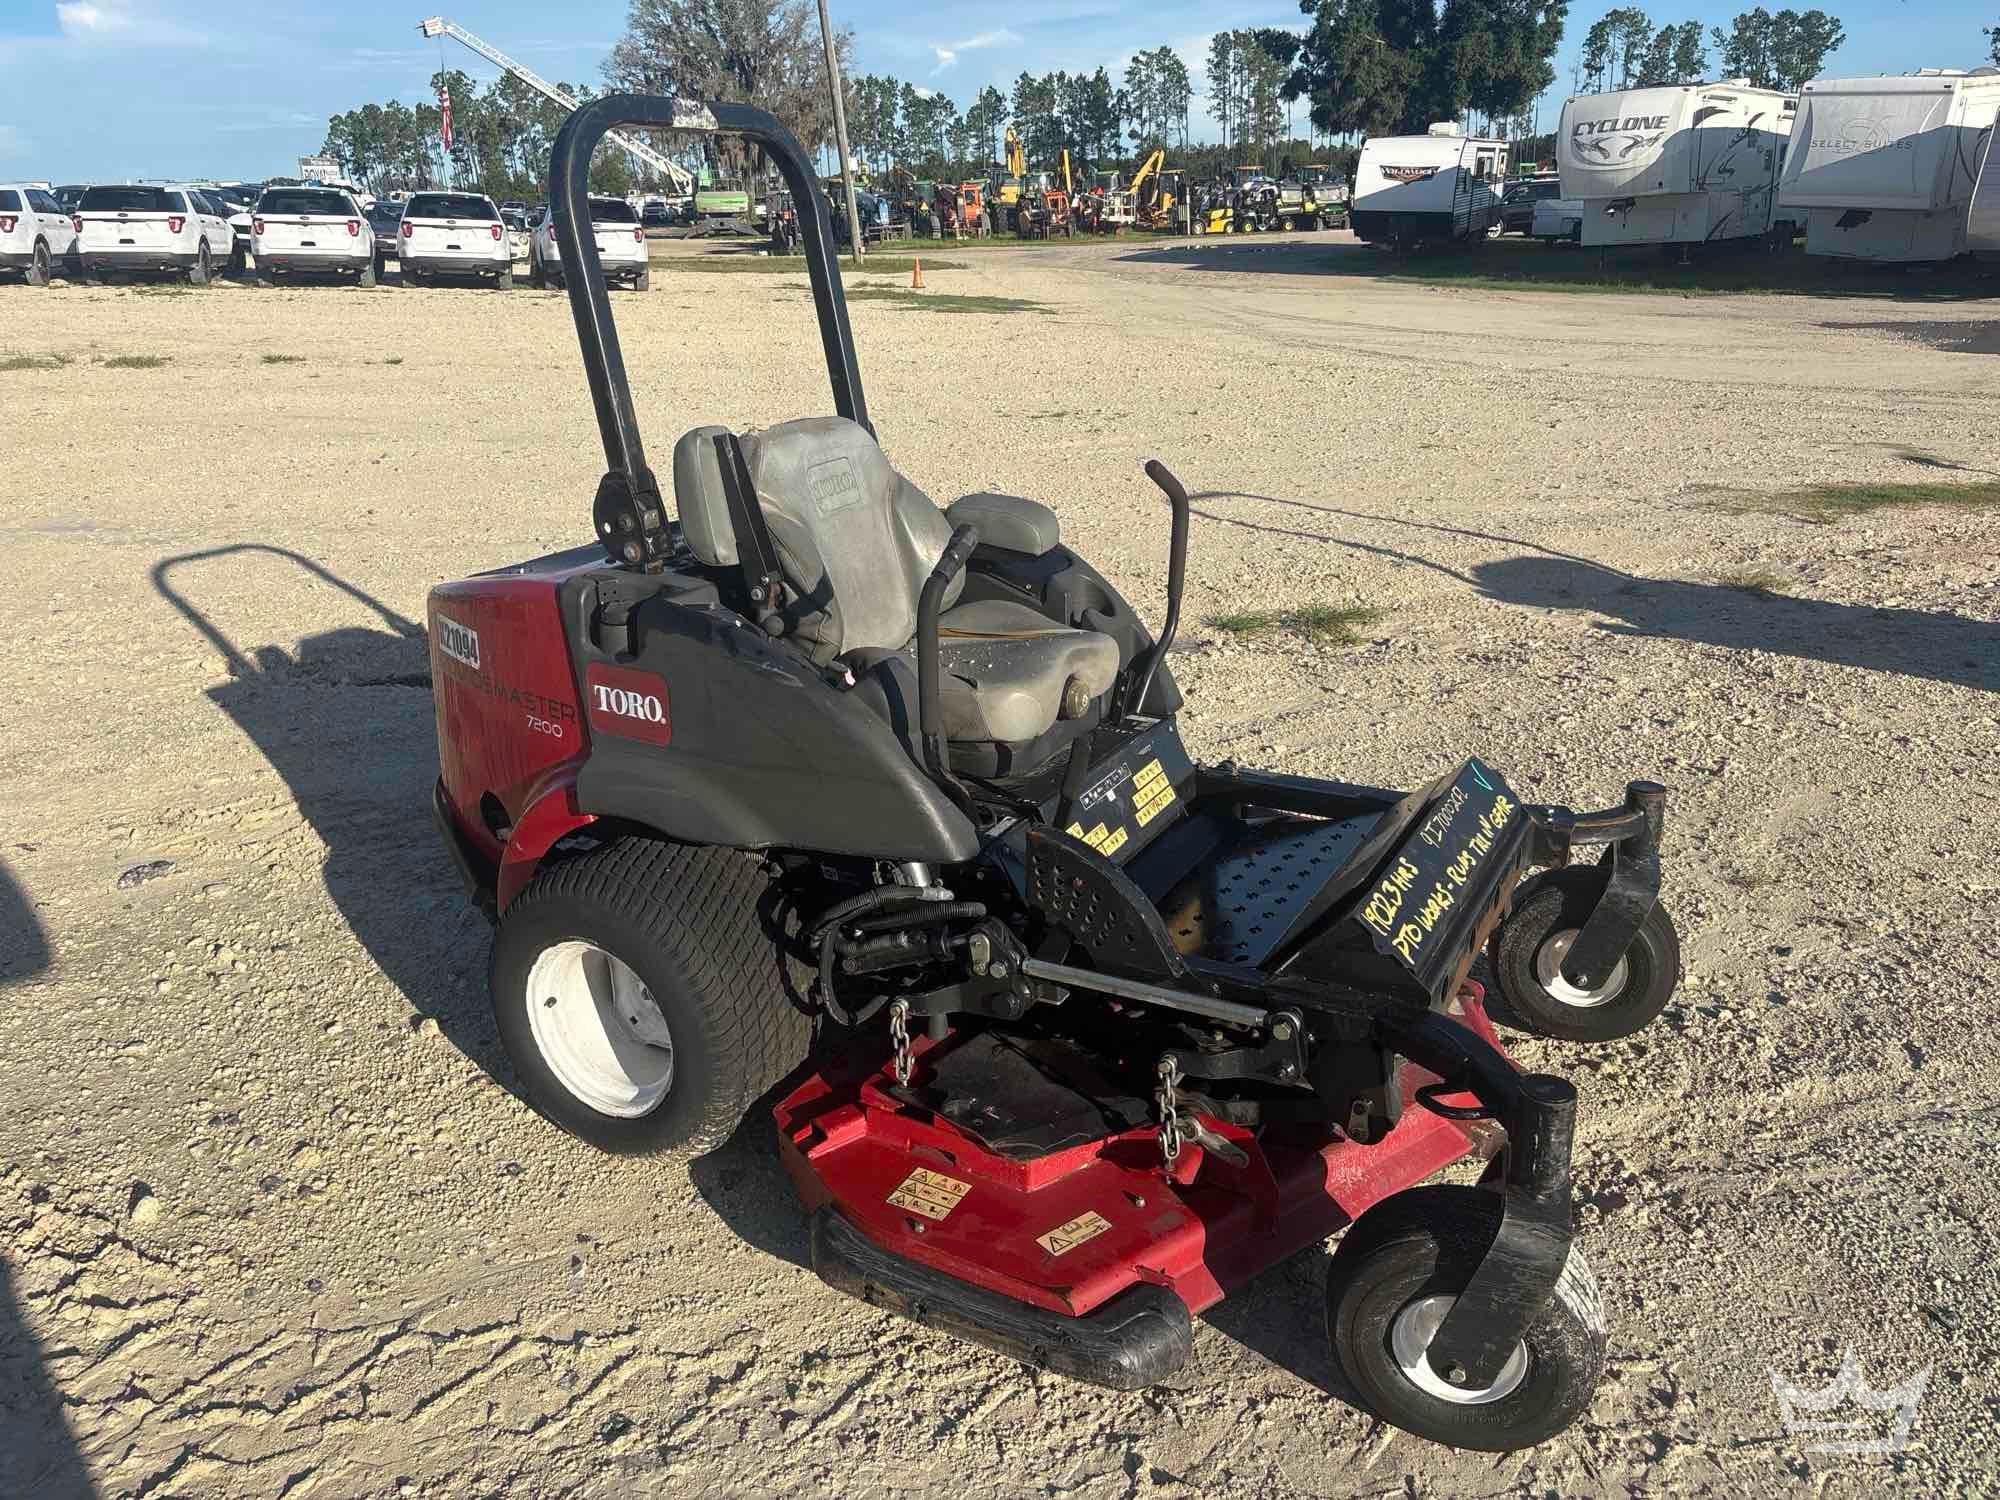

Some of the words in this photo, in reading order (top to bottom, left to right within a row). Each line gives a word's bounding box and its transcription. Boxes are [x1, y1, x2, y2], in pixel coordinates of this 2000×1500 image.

[1573, 115, 1670, 136] CYCLONE
[526, 714, 563, 738] 7200
[1391, 922, 1422, 966] PTO
[1413, 881, 1455, 932] WORKS
